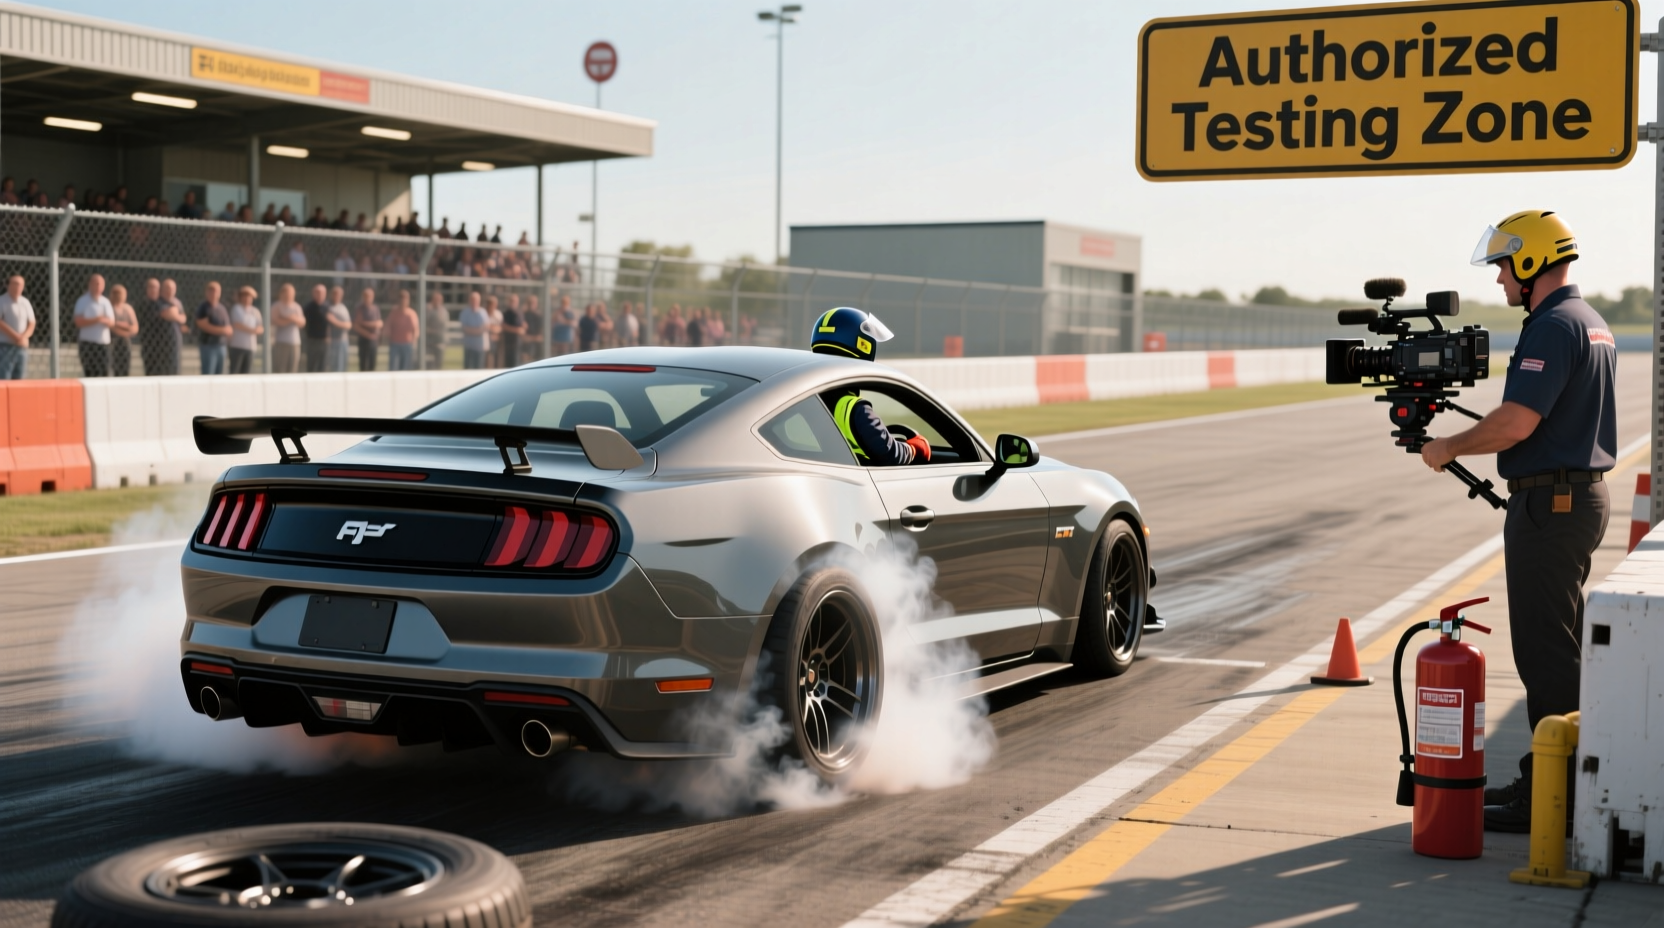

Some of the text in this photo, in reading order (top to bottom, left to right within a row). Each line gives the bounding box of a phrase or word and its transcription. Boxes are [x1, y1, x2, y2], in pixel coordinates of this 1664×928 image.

[1199, 17, 1558, 88] Authorized
[1172, 91, 1592, 161] Testing Zone
